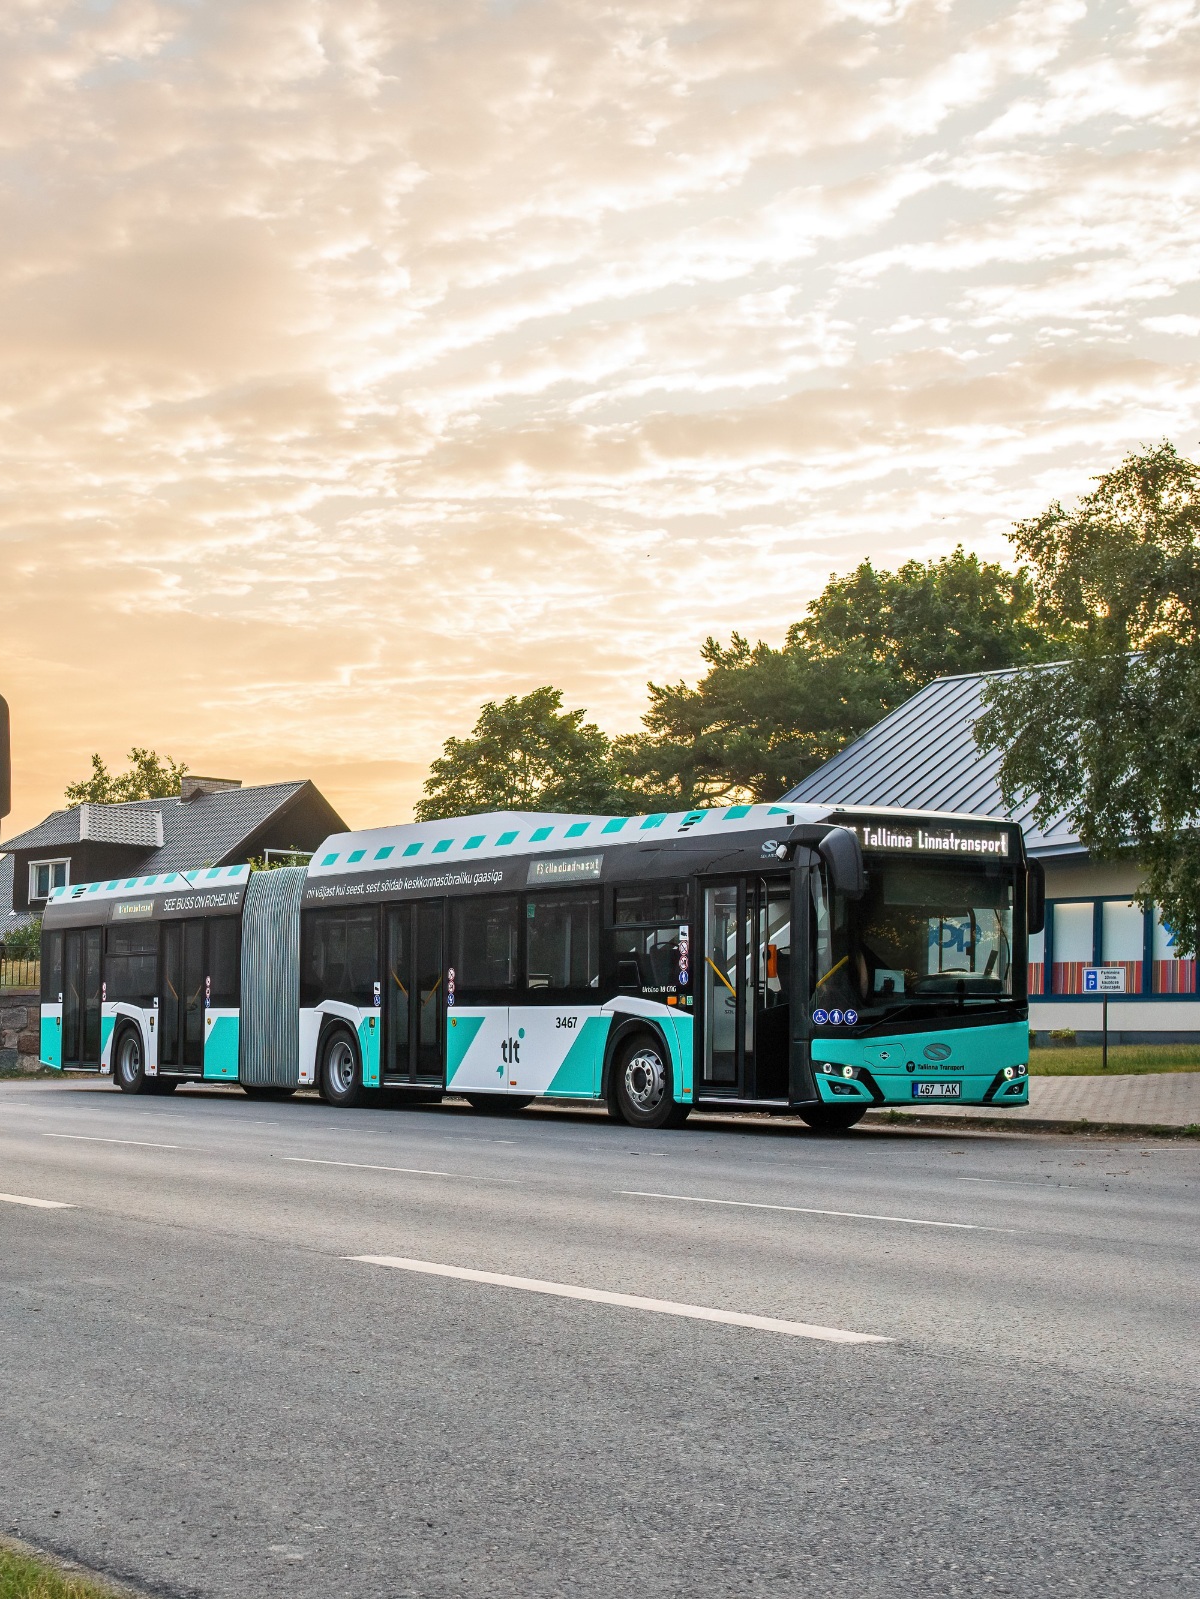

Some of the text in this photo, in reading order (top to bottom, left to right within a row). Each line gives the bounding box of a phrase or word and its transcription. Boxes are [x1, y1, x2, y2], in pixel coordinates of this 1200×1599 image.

[863, 827, 913, 848] Tallinna
[918, 830, 1007, 853] Linnatransport
[366, 881, 380, 894] sest
[473, 869, 503, 886] gaasiga
[163, 898, 177, 911] SEE
[176, 896, 195, 910] BUSS
[194, 895, 205, 909] ON
[555, 1016, 578, 1029] 3467
[501, 1037, 520, 1064] tlt
[920, 1084, 958, 1095] 467 TAK
